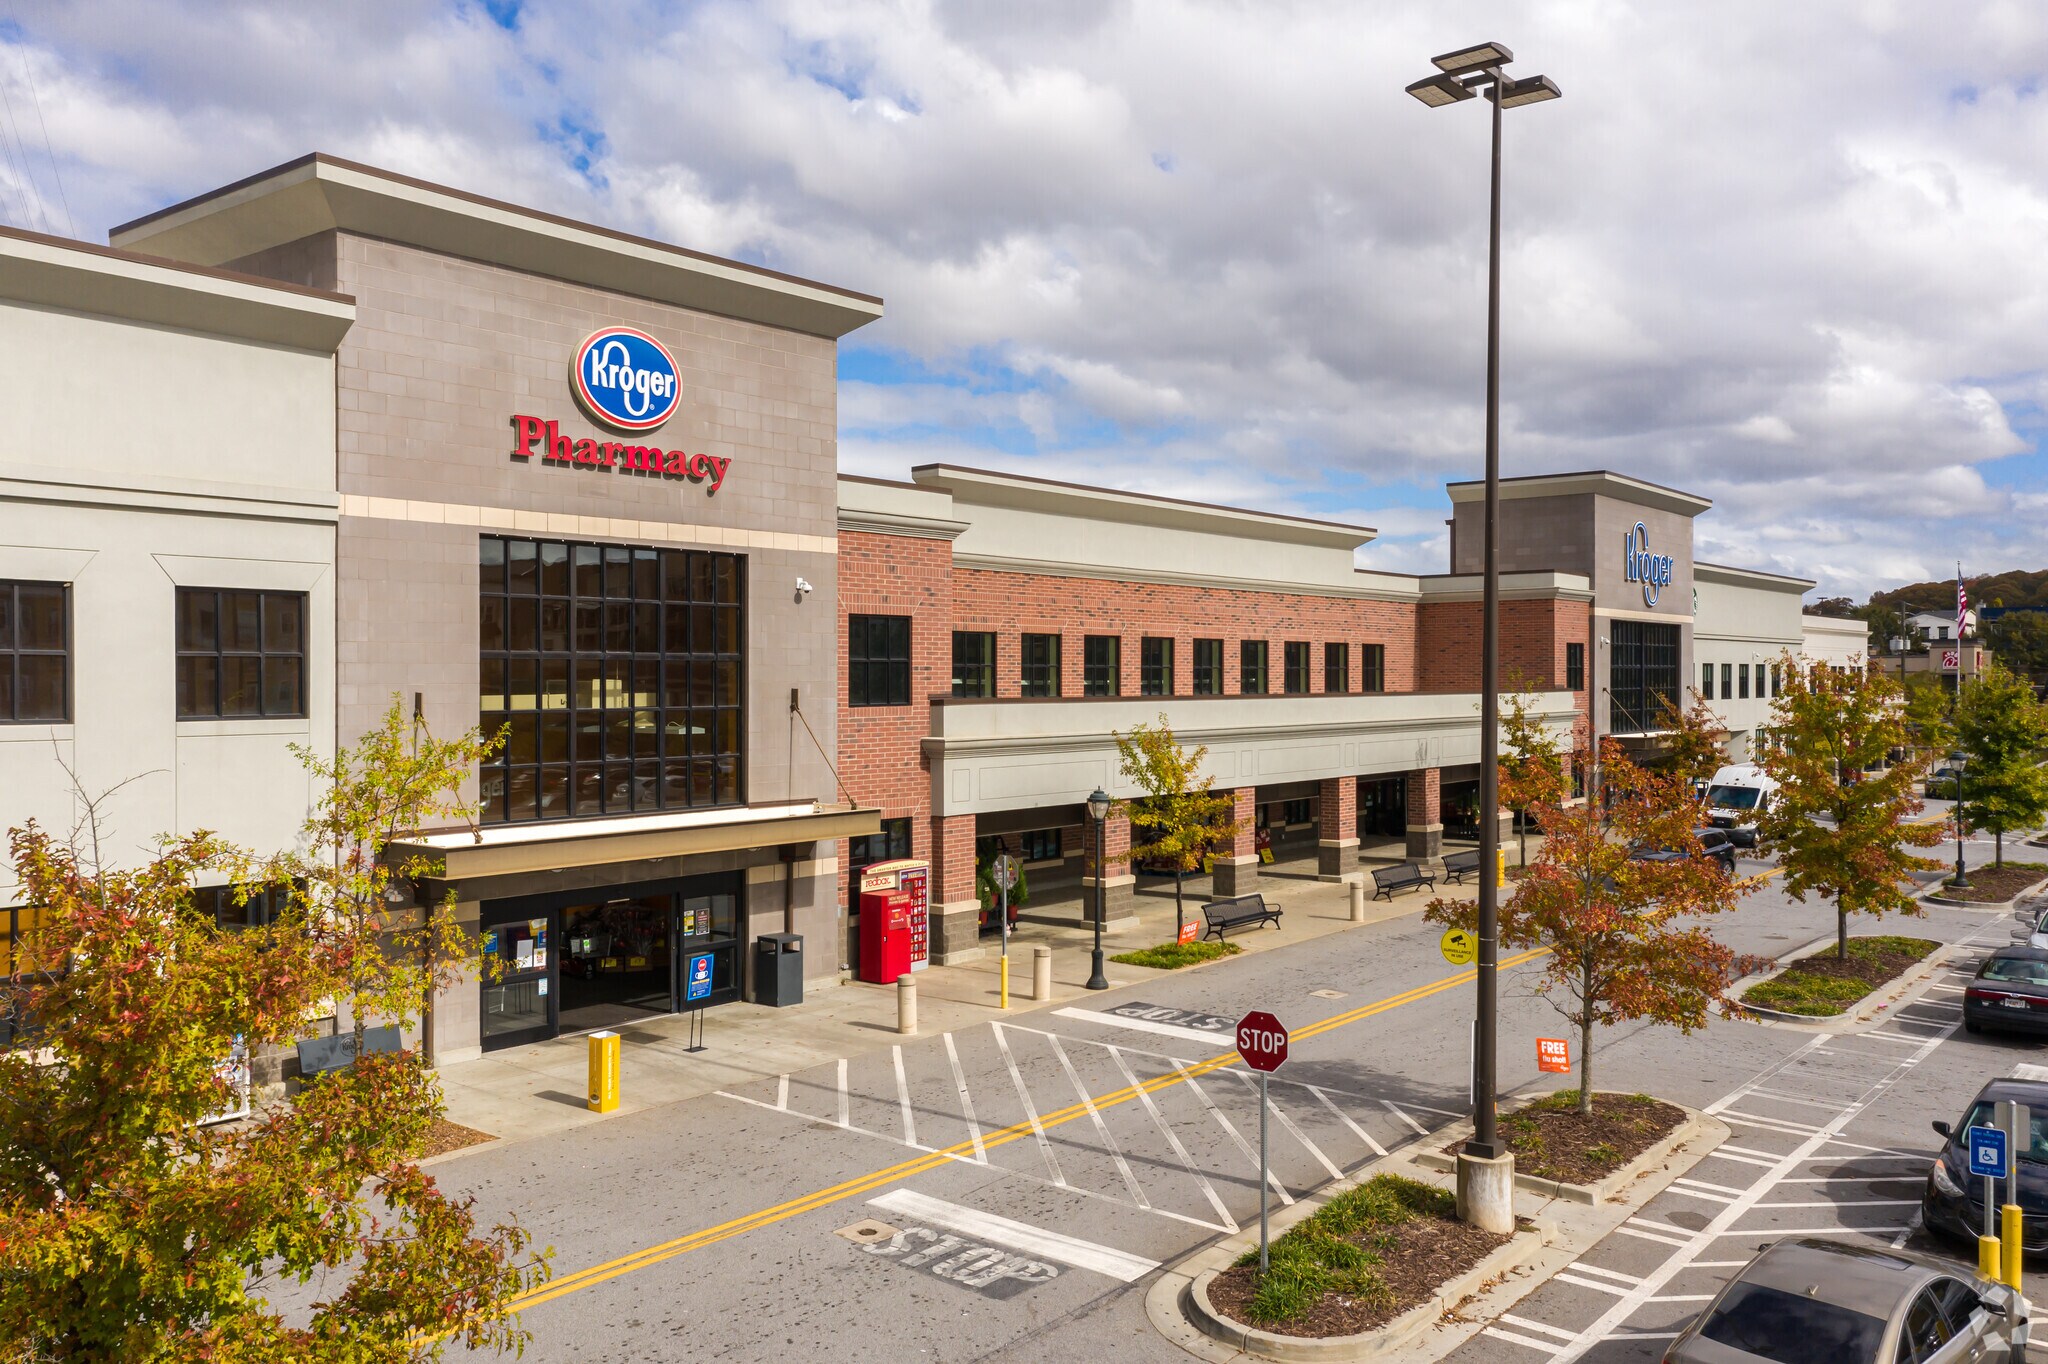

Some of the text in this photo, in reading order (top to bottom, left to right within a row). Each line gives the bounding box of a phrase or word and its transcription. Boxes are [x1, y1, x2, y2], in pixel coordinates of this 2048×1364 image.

[591, 340, 675, 417] Kroger
[511, 414, 732, 492] Pharmacy
[1625, 520, 1674, 607] Kroger
[1114, 1006, 1235, 1029] STOP
[1240, 1028, 1286, 1054] STOP
[1541, 1041, 1566, 1055] FREE
[862, 1227, 1059, 1288] STOP
